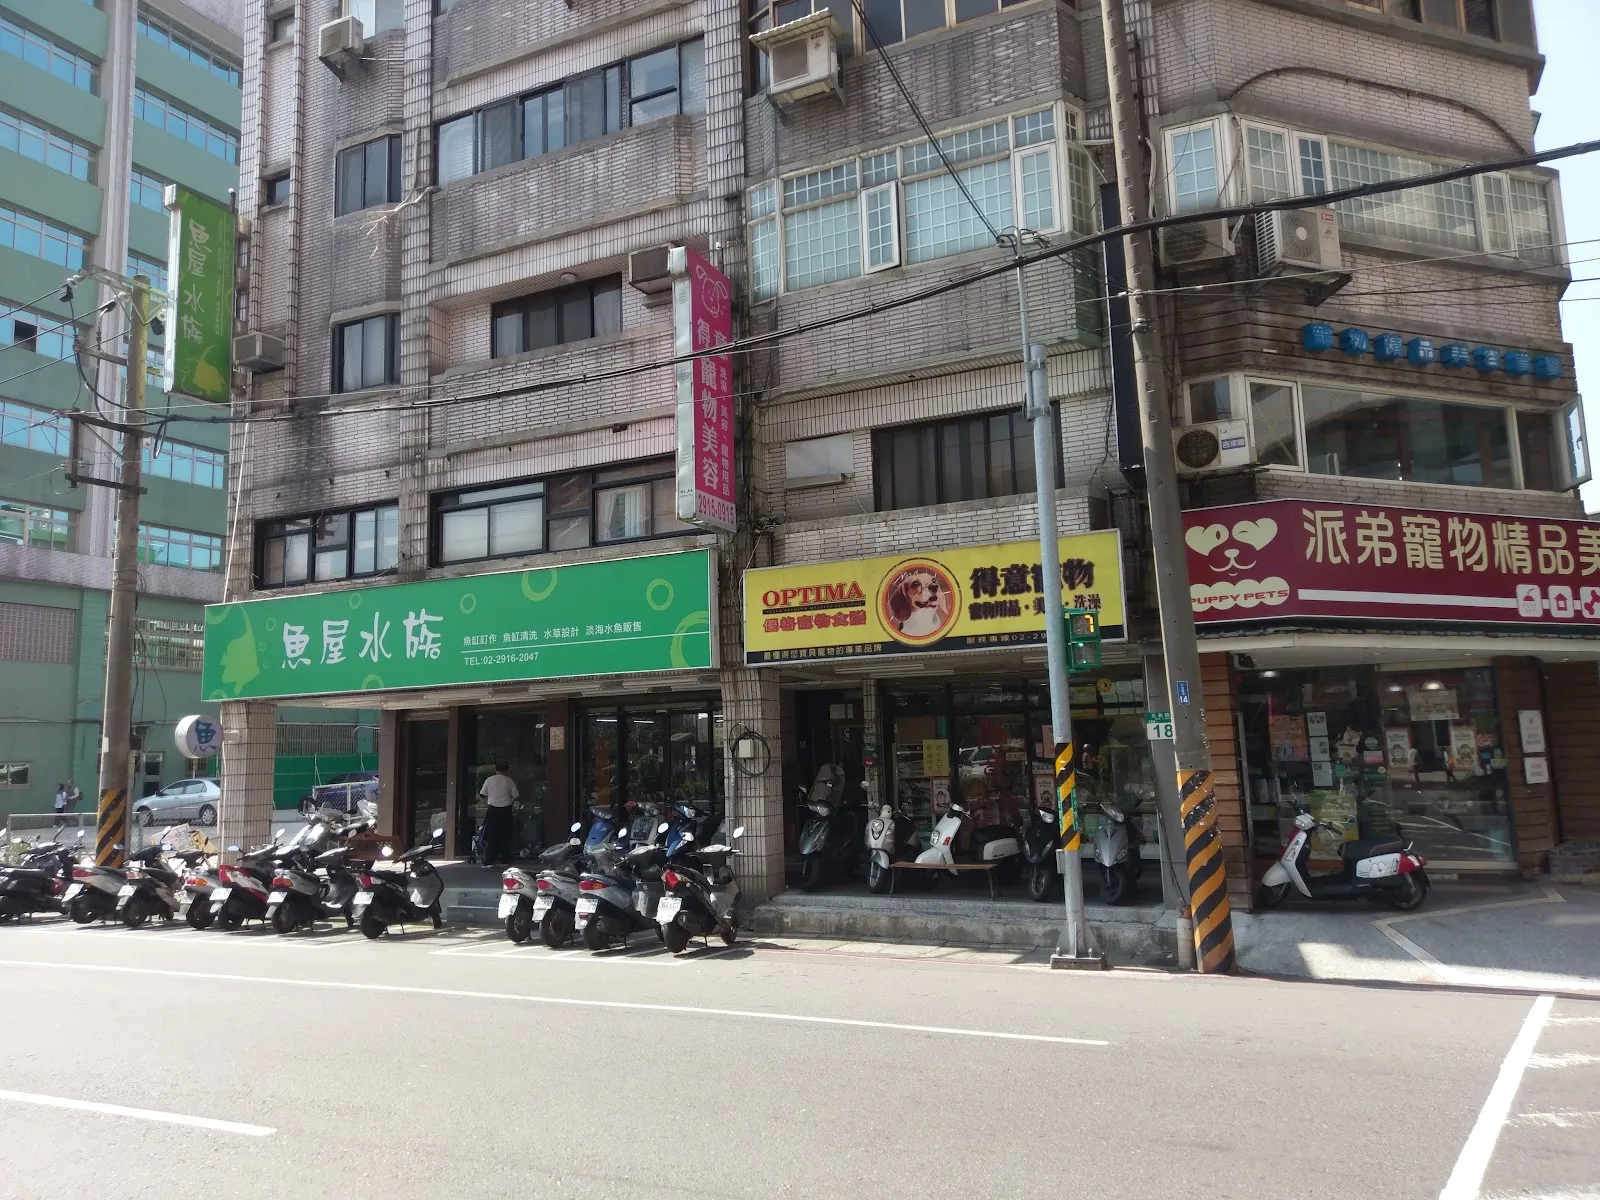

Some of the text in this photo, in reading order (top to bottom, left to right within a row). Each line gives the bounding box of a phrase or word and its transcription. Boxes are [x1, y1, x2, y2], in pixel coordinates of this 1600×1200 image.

[181, 217, 212, 344] 魚屋水族
[762, 580, 866, 608] OPTIMA
[1243, 589, 1289, 600] PETS
[281, 608, 444, 669] 魚屋水族
[463, 621, 642, 646] 魚缸訂作 魚缸清洗 水草設計 淡海水魚販售
[464, 652, 539, 666] TEL:02-2916-2047
[1179, 695, 1188, 704] 14
[193, 719, 217, 752] 魚
[1153, 724, 1173, 738] 18
